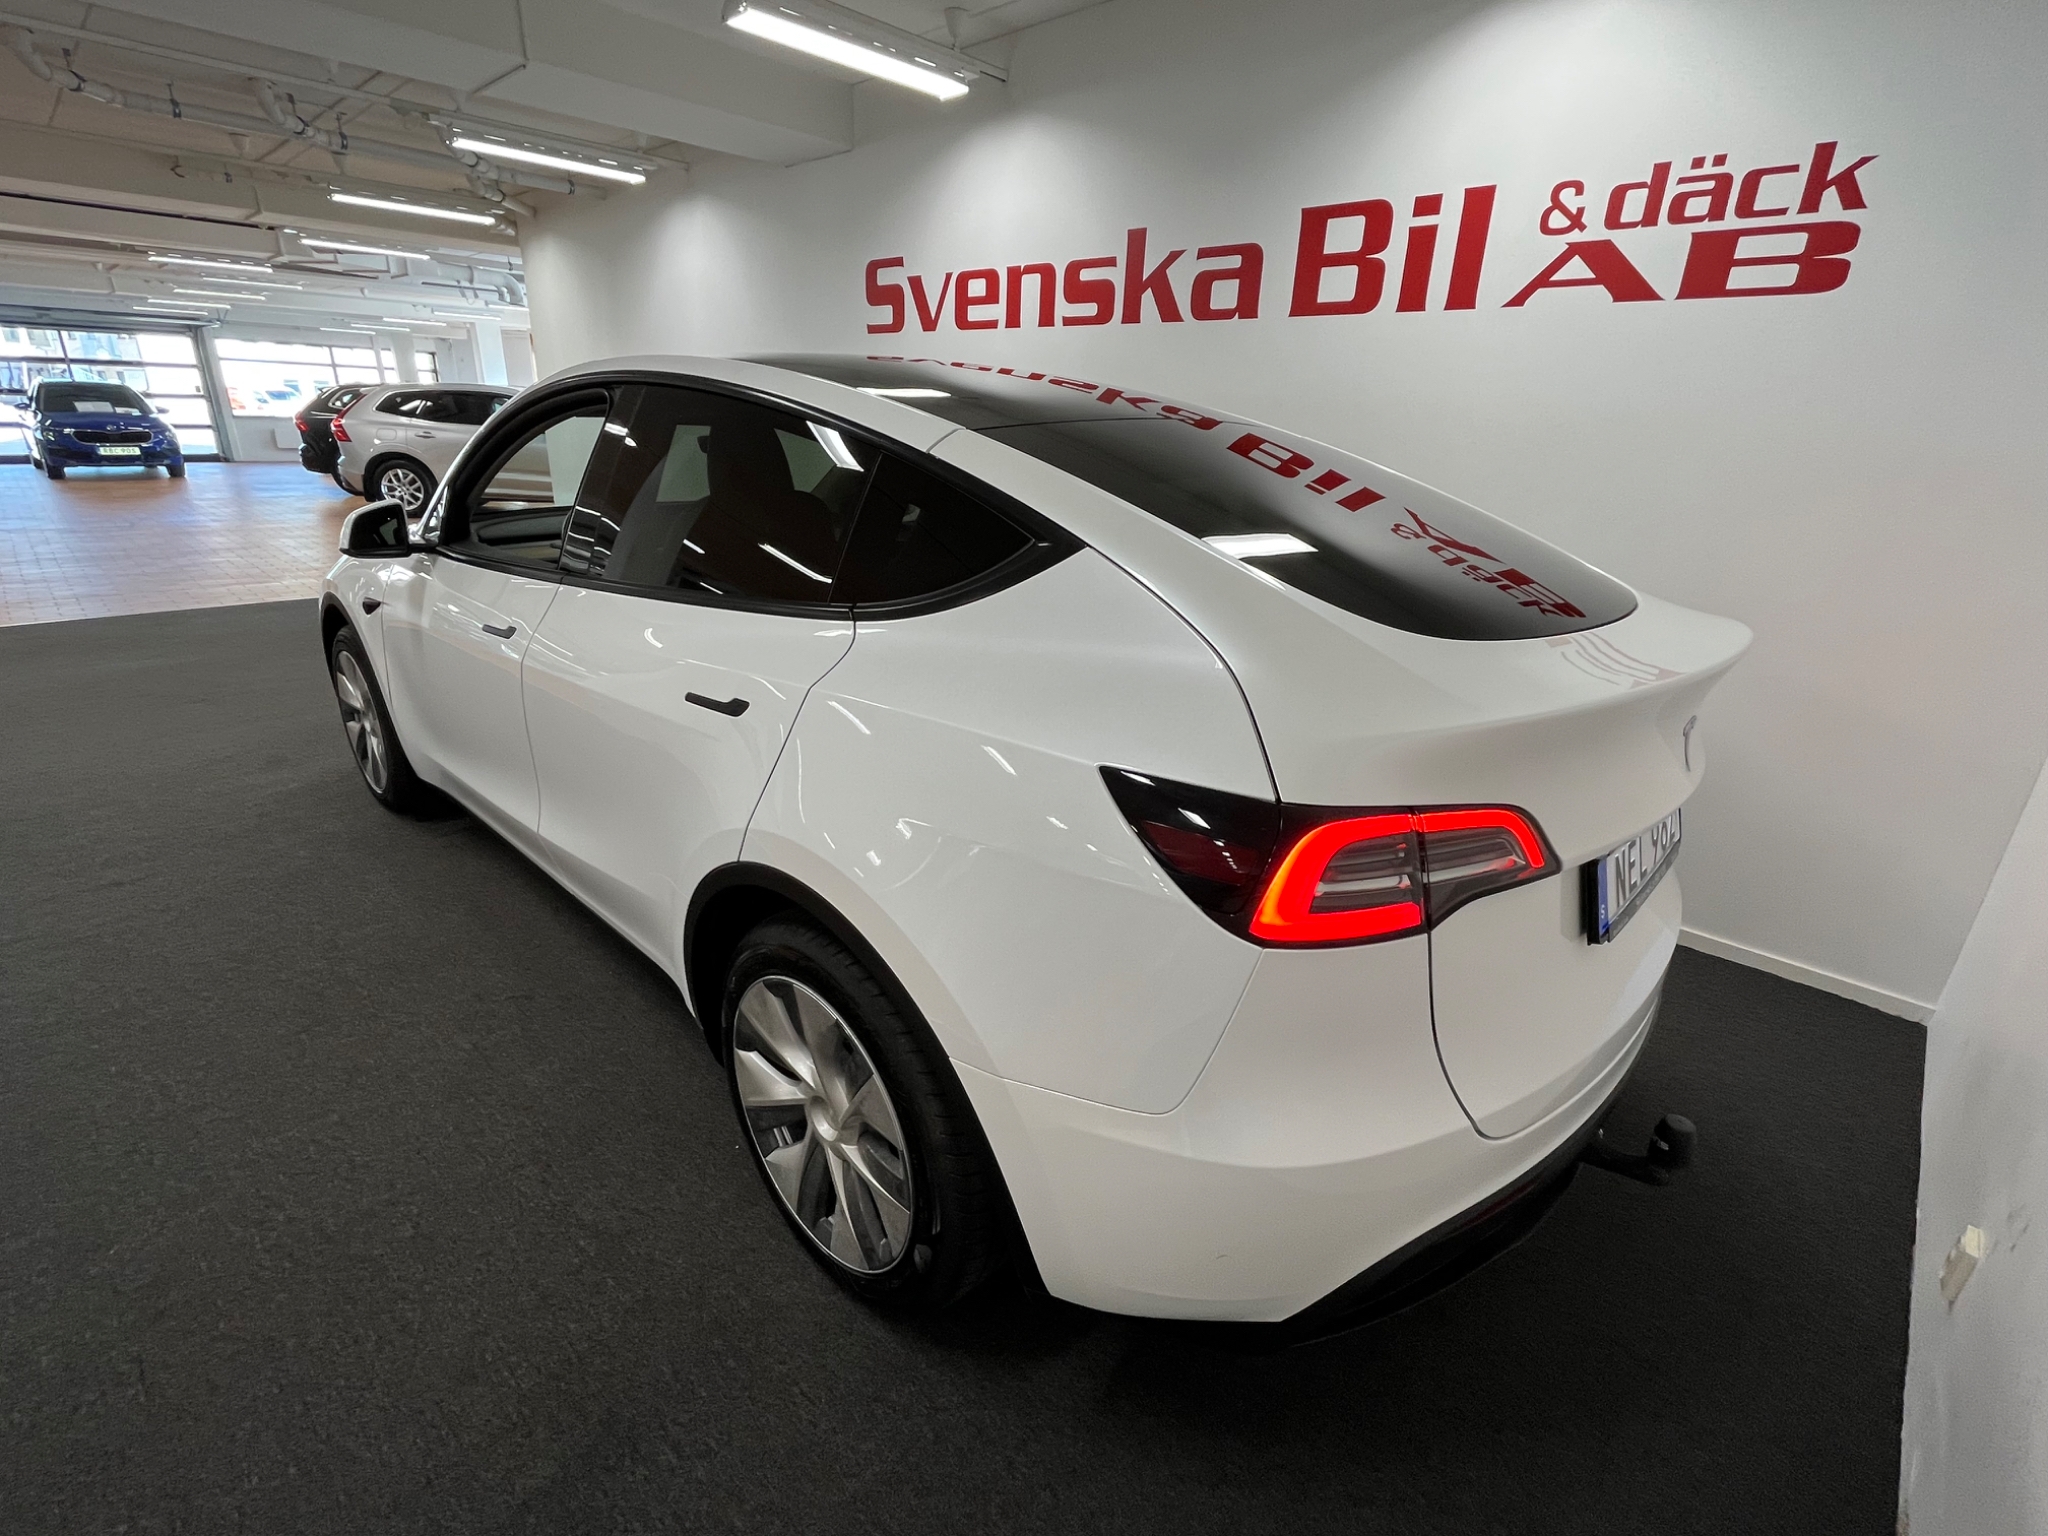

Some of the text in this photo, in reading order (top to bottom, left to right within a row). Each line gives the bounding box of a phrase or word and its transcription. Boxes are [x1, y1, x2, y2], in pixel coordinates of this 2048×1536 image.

[1539, 141, 1879, 236] & däck
[865, 184, 1862, 334] Svenska Bil AB
[1615, 836, 1648, 908] NEL
